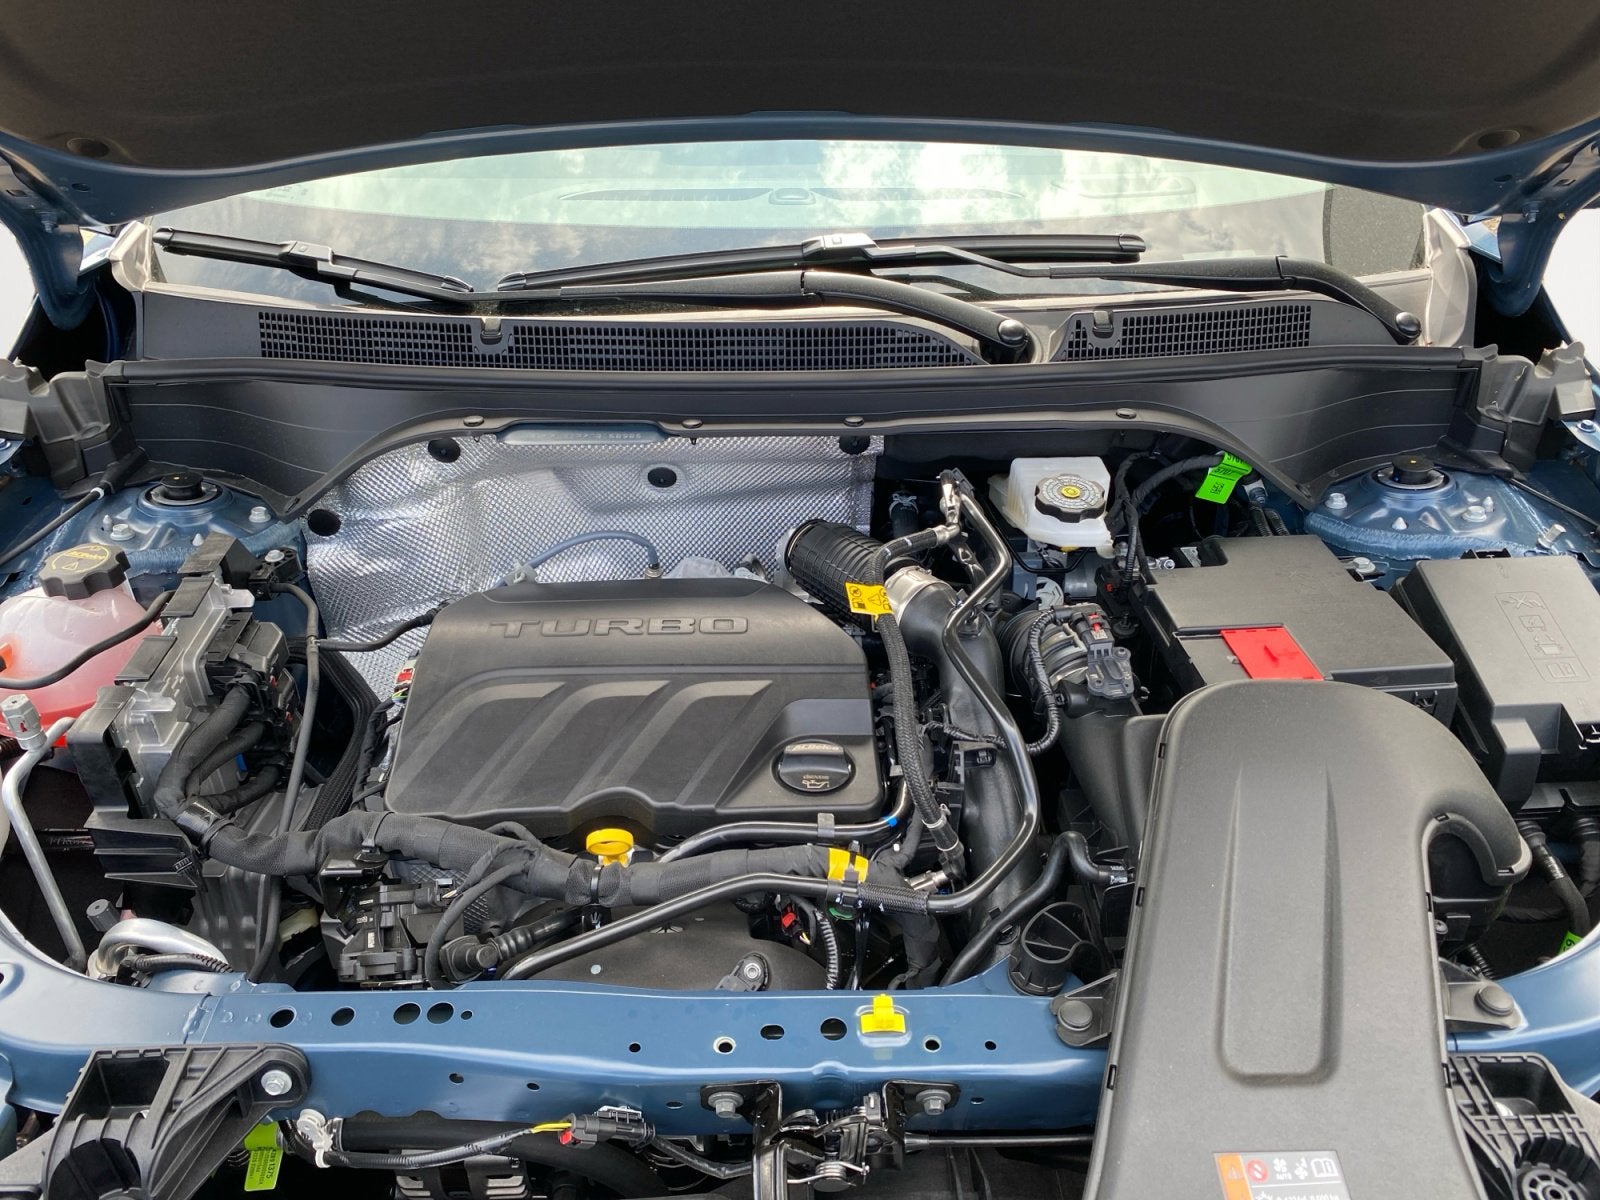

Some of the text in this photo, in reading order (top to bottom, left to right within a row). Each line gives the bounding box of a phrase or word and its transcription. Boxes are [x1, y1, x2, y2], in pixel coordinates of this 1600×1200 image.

[490, 616, 749, 639] TURBO
[792, 743, 840, 752] ACDelco
[1275, 1172, 1293, 1181] AUTO
